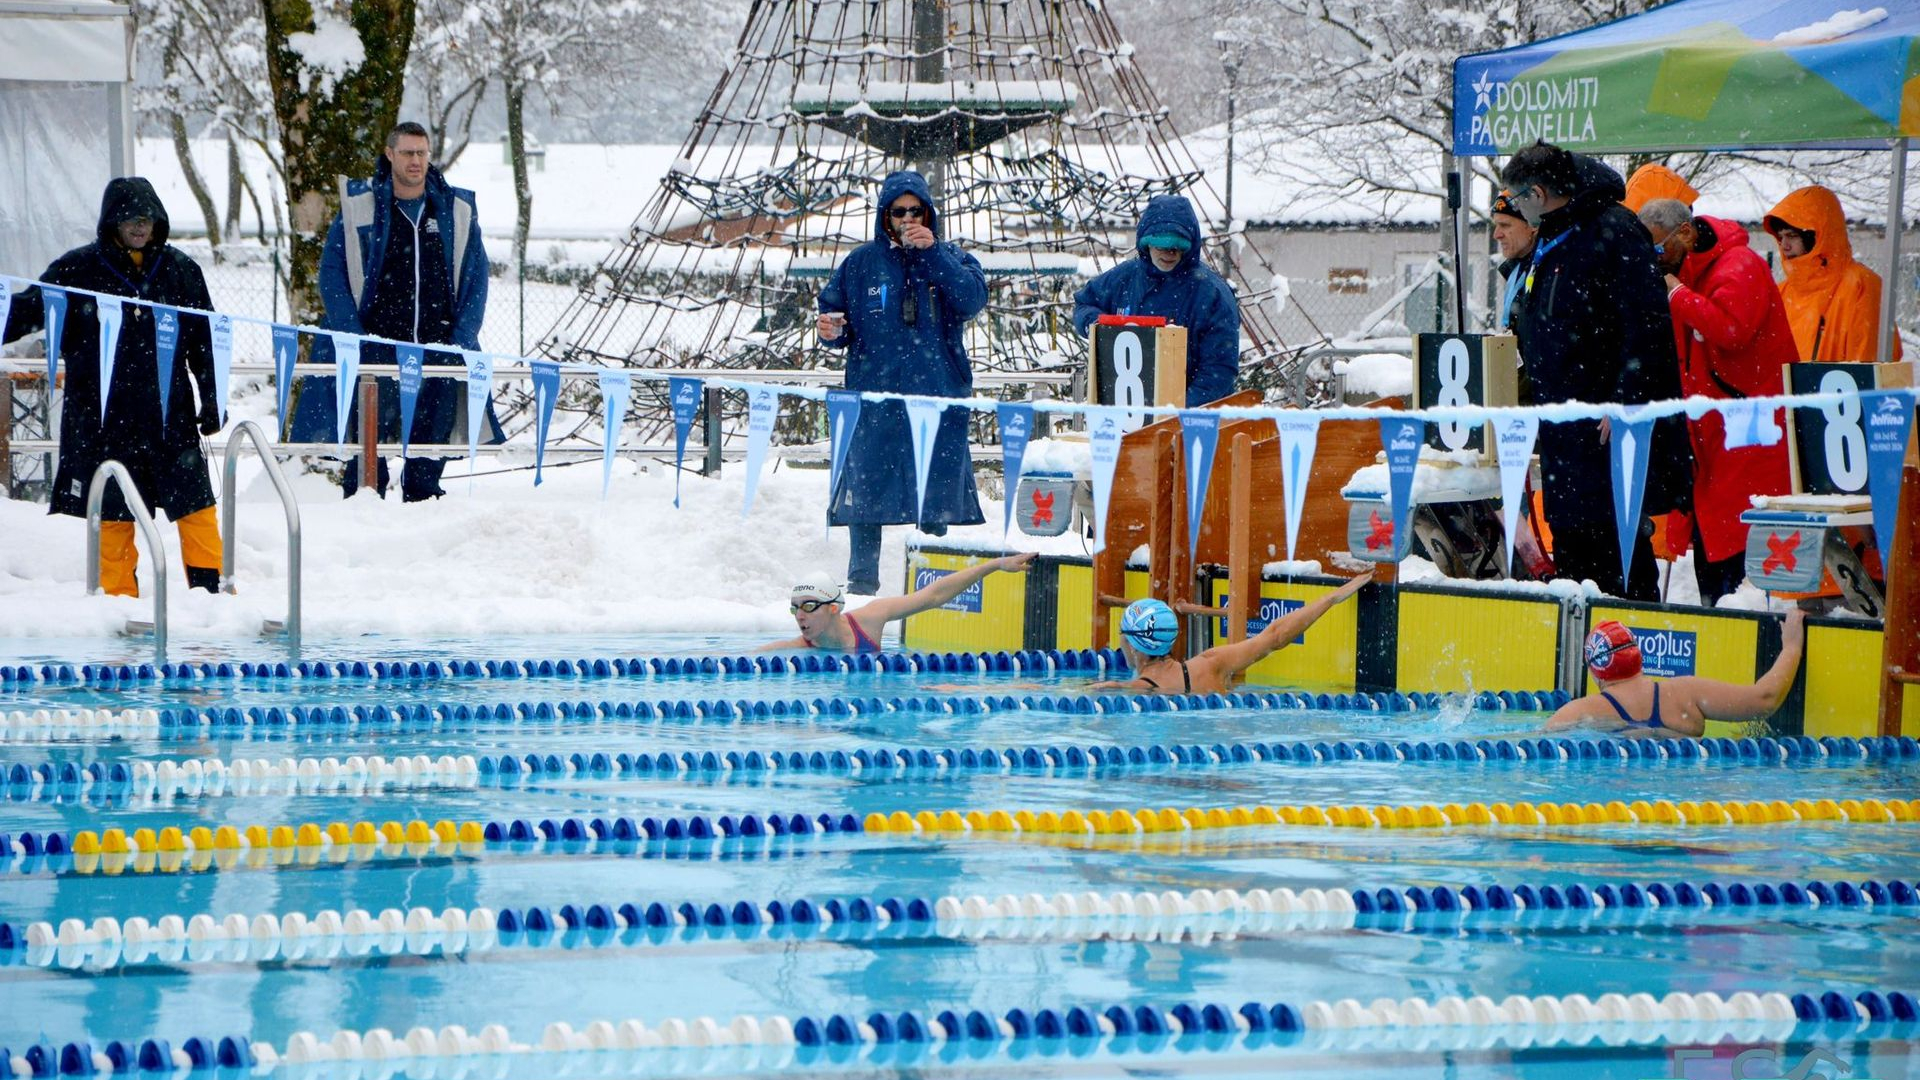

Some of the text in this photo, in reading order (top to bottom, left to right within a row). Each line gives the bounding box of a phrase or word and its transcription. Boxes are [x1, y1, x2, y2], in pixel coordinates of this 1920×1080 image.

[1497, 77, 1598, 111] DOLOMITI
[1470, 110, 1597, 148] PAGANELLA
[1113, 331, 1145, 434] 8
[1438, 338, 1470, 450] 8
[1820, 369, 1869, 492] 8
[1871, 413, 1904, 426] Delfina
[1837, 564, 1878, 618] 3
[1668, 657, 1690, 667] TIMING
